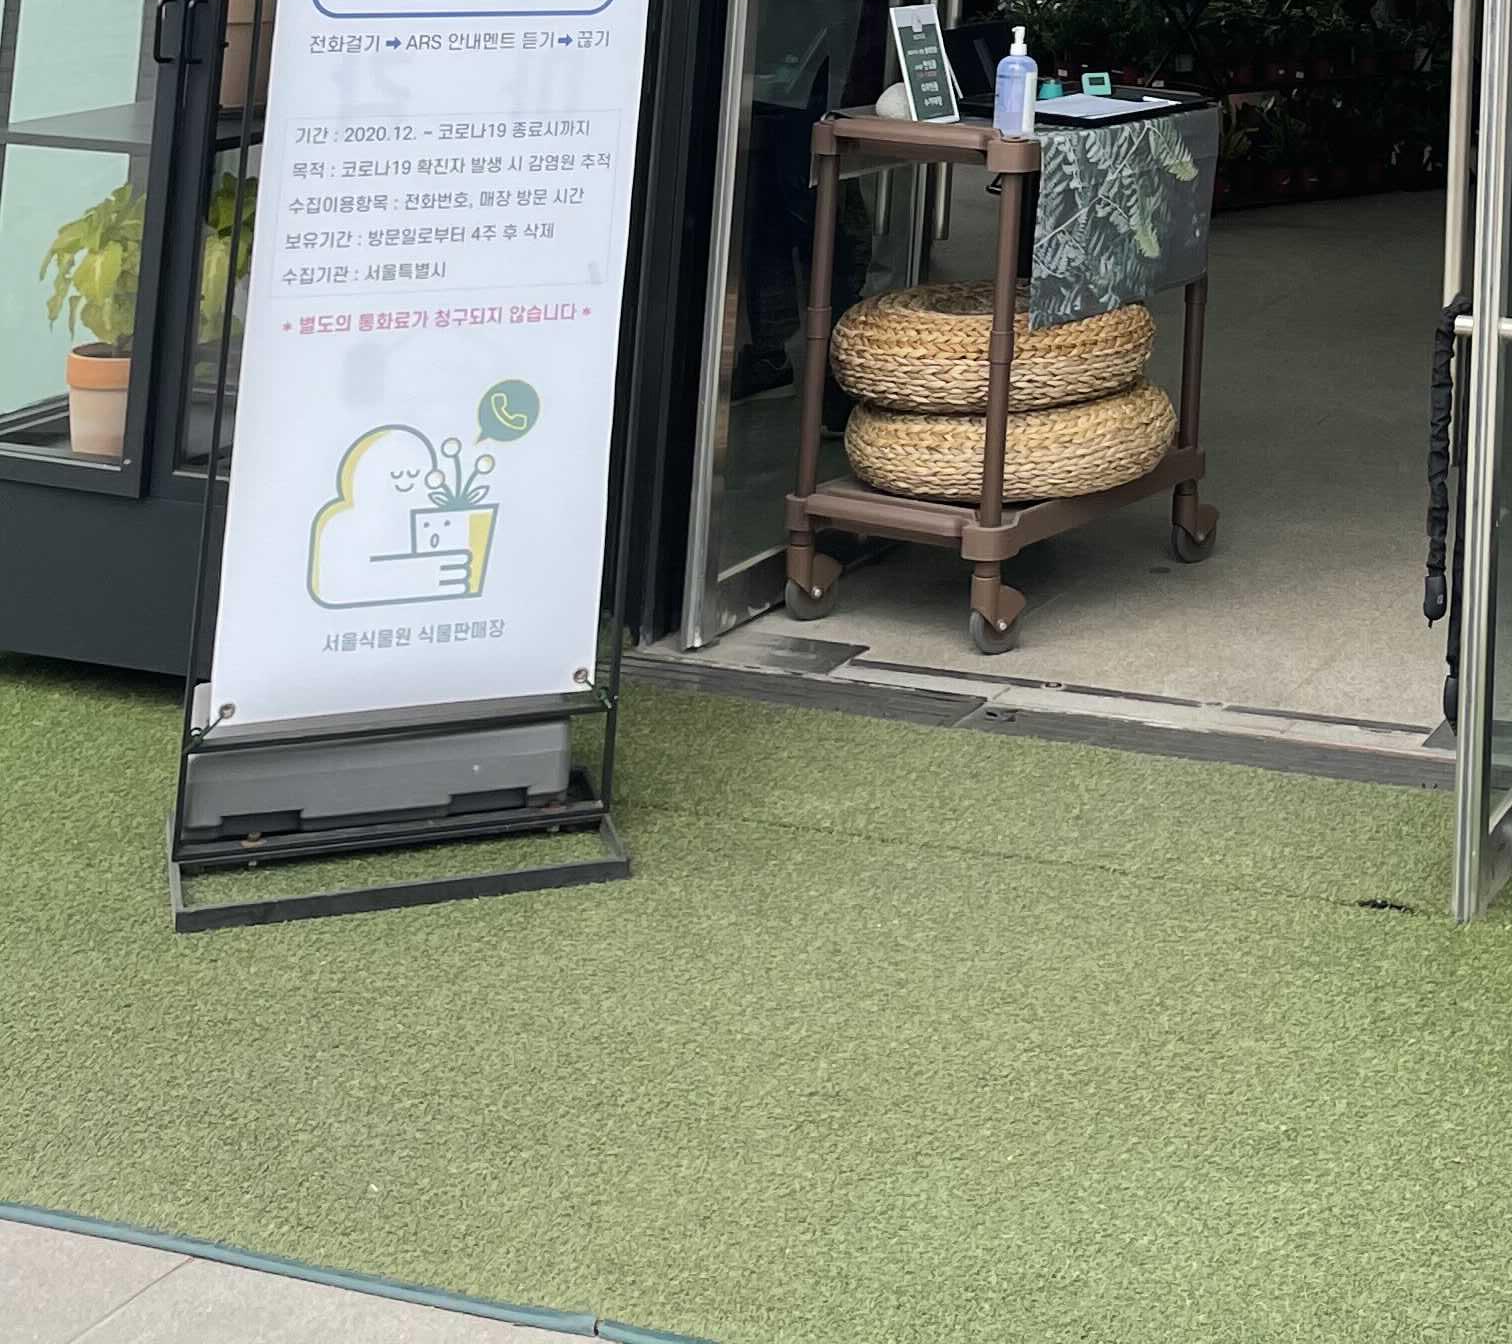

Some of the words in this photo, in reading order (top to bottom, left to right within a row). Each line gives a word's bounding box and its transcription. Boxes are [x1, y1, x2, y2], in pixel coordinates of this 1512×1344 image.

[309, 34, 380, 55] 전화걸기
[405, 34, 442, 50] ARS
[448, 32, 515, 52] 안내멘트
[521, 31, 555, 50] 듣기
[296, 126, 329, 144] 기간
[438, 123, 507, 140] 코로나19
[512, 120, 590, 138] 종료시까지
[292, 161, 325, 179] 목적
[341, 160, 411, 178] 코로나19
[417, 157, 466, 175] 확진자
[471, 156, 502, 174] 발생
[528, 152, 575, 172] 감염원
[580, 152, 611, 172] 추적
[288, 195, 388, 214] 수집이용항목
[480, 190, 512, 207] 매장
[517, 189, 547, 206] 방문
[553, 187, 584, 204] 시간
[285, 231, 353, 250] 보유기간
[368, 226, 465, 247] 방문일로부터
[471, 224, 497, 242] 4주
[523, 222, 555, 240] 삭제
[281, 265, 350, 285] 수집기관
[364, 261, 446, 281] 서울특별시
[300, 314, 352, 335] 별도의
[359, 310, 429, 332] 통화료가
[434, 303, 503, 328] 청구되지
[510, 302, 577, 324] 않습니다
[322, 627, 412, 653] 서울식물원
[418, 618, 507, 644] 식물판매장
